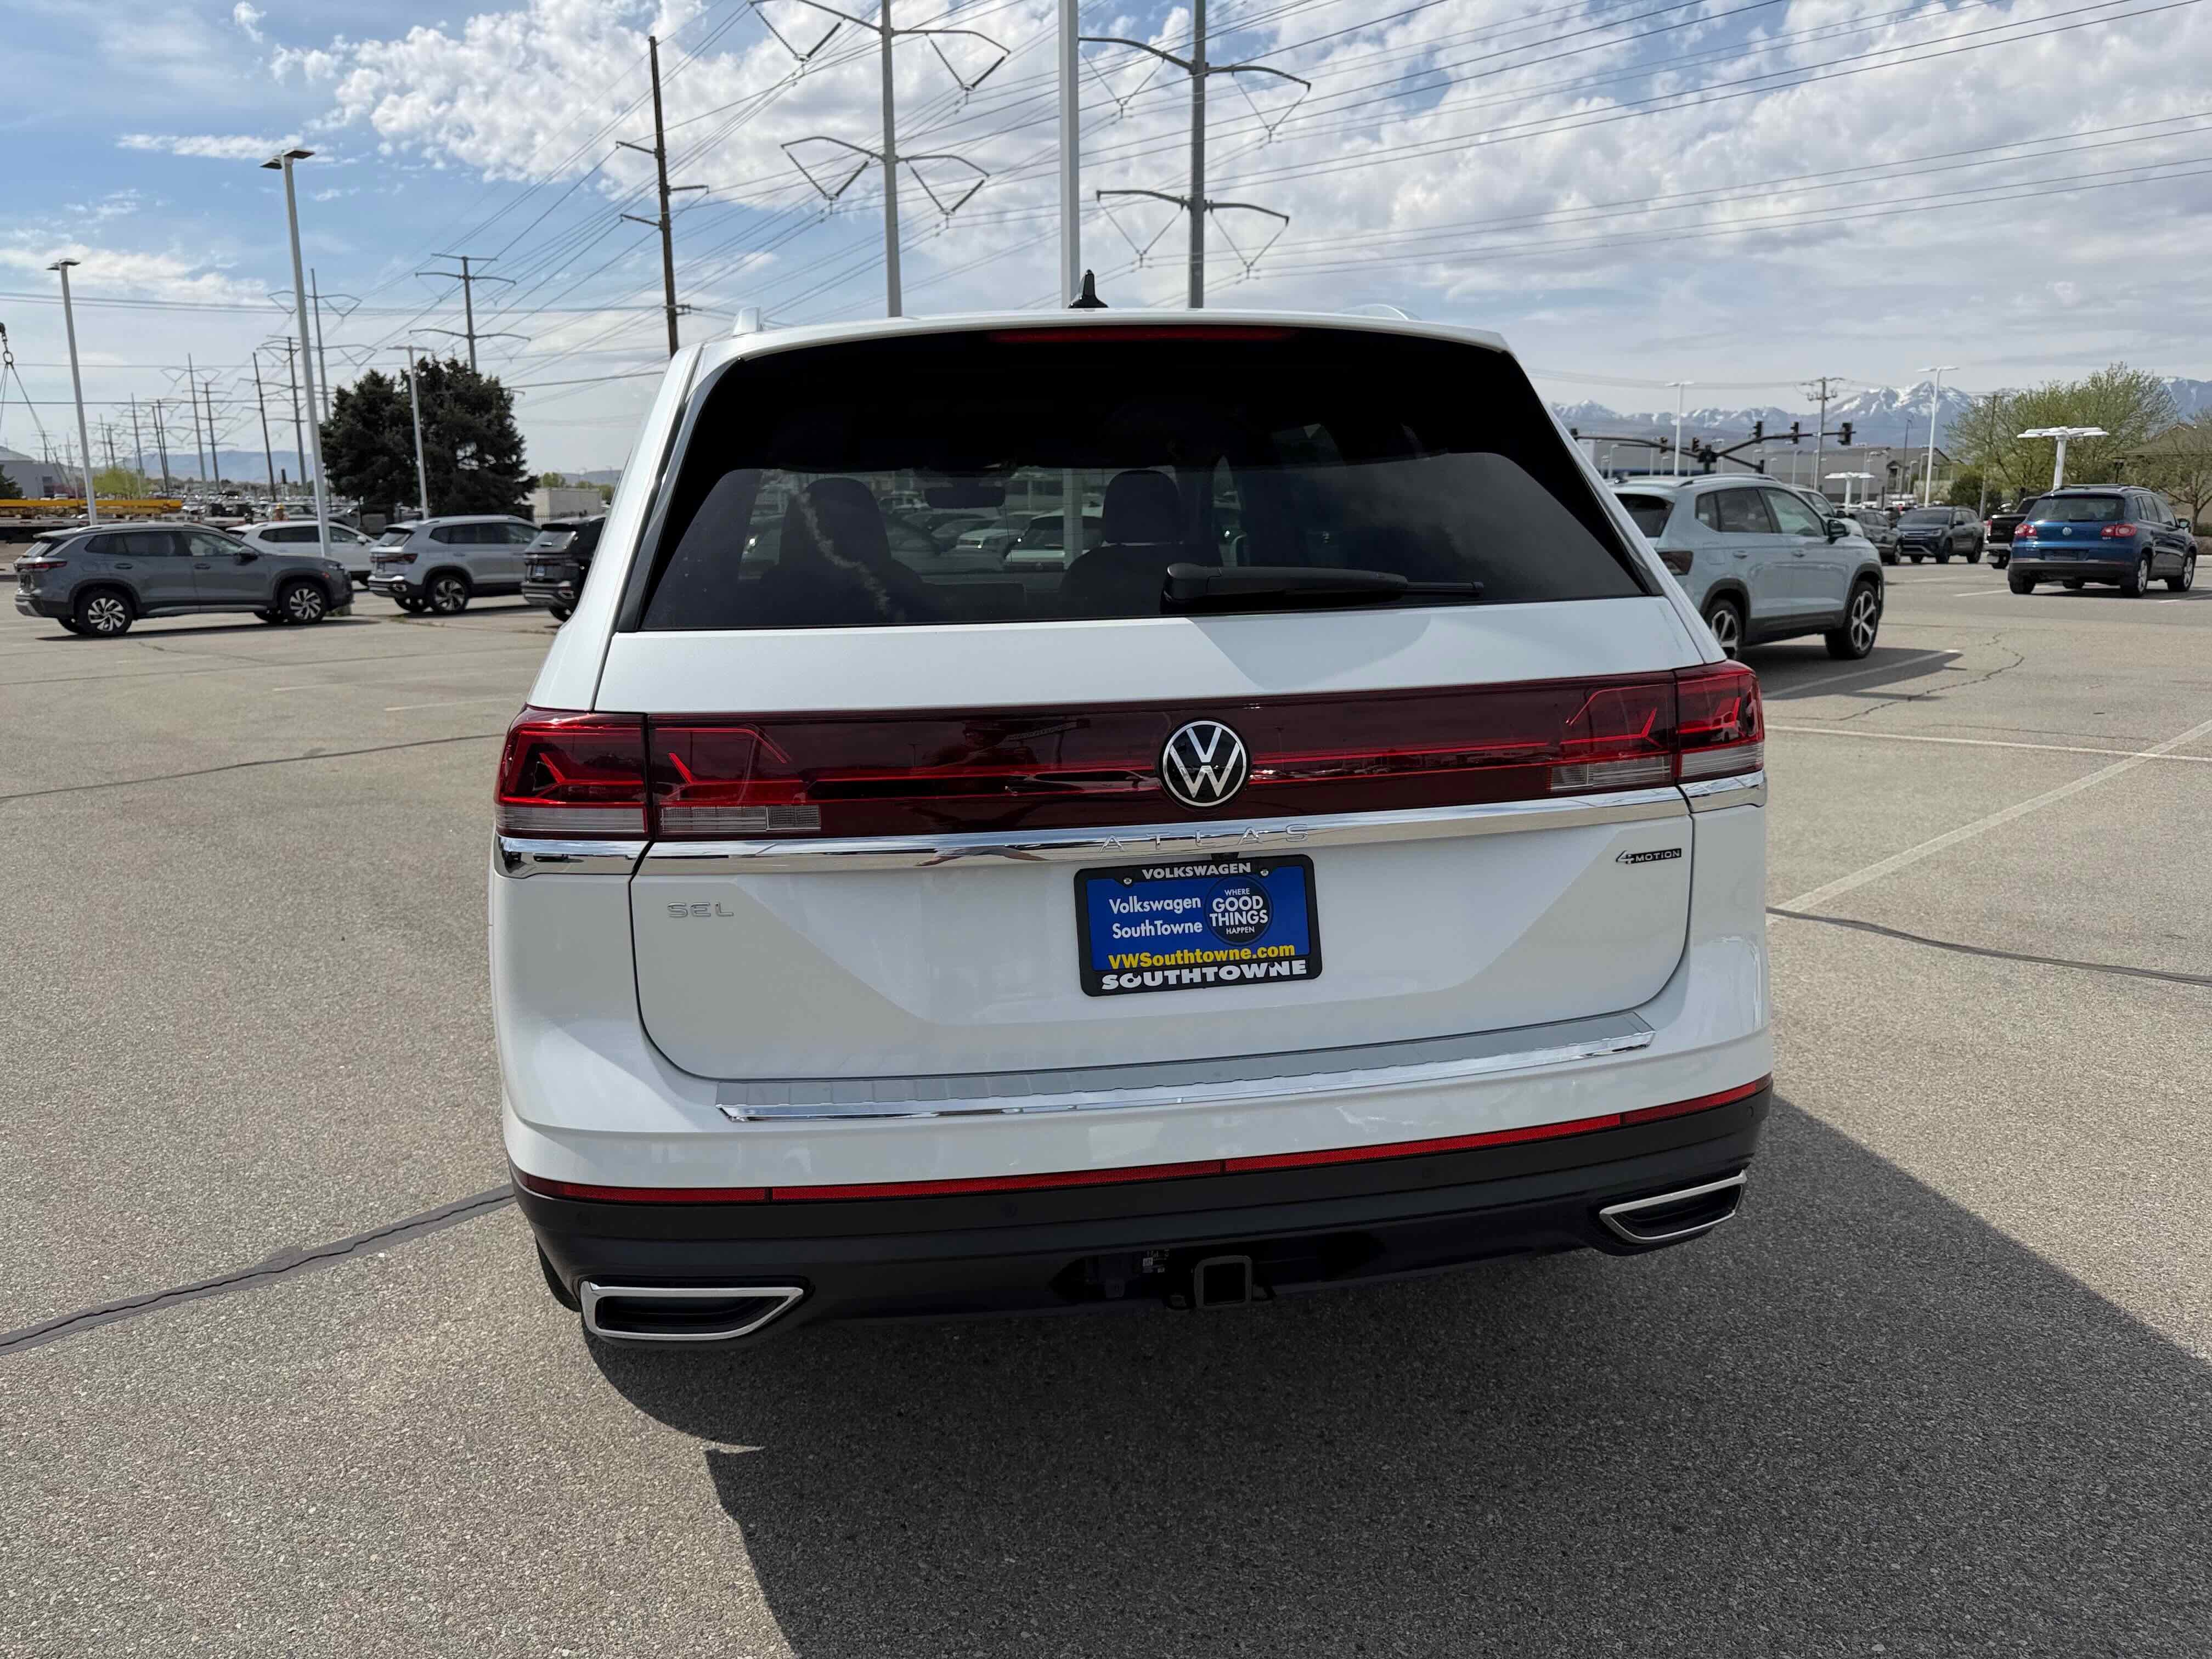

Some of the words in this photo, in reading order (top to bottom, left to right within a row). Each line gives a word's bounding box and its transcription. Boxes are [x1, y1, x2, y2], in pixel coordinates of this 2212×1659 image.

[1168, 726, 1241, 799] VW
[1098, 824, 1308, 853] ATLAS
[1142, 862, 1251, 879] VOLKSWAGEN
[1224, 888, 1250, 896] WHERE
[667, 901, 734, 918] SEL
[1108, 895, 1201, 915] Volkswagen
[1212, 895, 1263, 912] GOOD
[1209, 909, 1268, 927] THINGS
[1112, 919, 1203, 939] SouthTowne
[1226, 926, 1255, 935] HAPPEN
[1108, 944, 1295, 970] VWSouthtowne.com
[1102, 960, 1307, 990] SOUTHTOWNE
